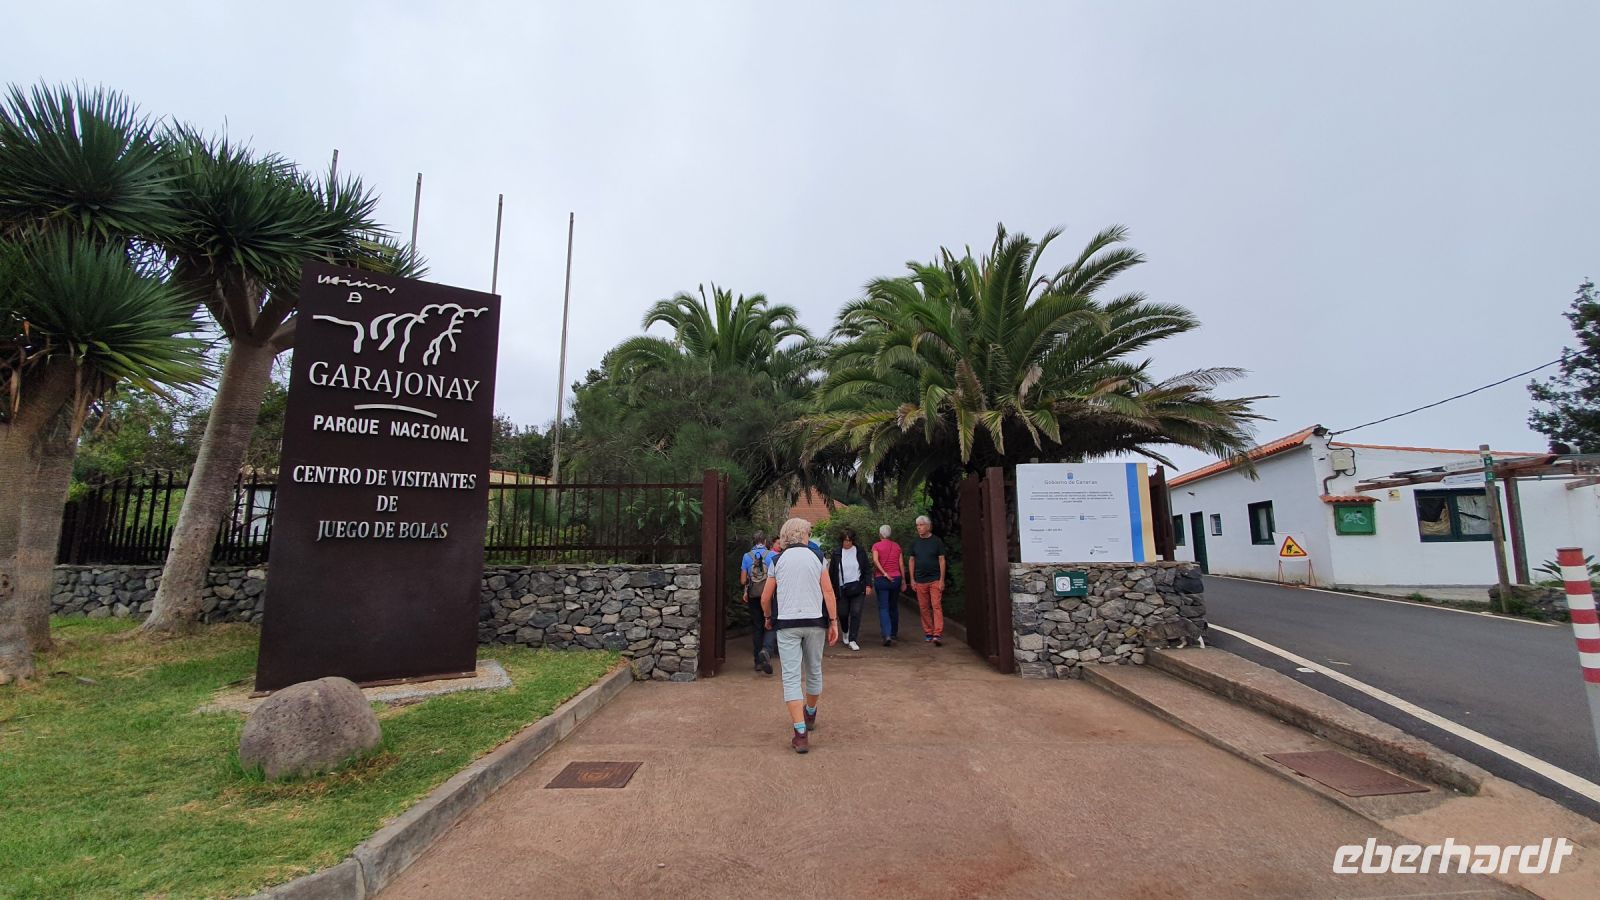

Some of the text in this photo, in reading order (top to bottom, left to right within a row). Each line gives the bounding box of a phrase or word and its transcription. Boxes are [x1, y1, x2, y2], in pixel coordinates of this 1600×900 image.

[309, 361, 480, 402] GARAJONAY
[313, 415, 469, 443] PARQUE NACIONAL
[293, 465, 477, 490] CENTRO DE VISITANTES
[376, 495, 398, 512] DE
[317, 520, 449, 542] JUEGO DE BOLAS
